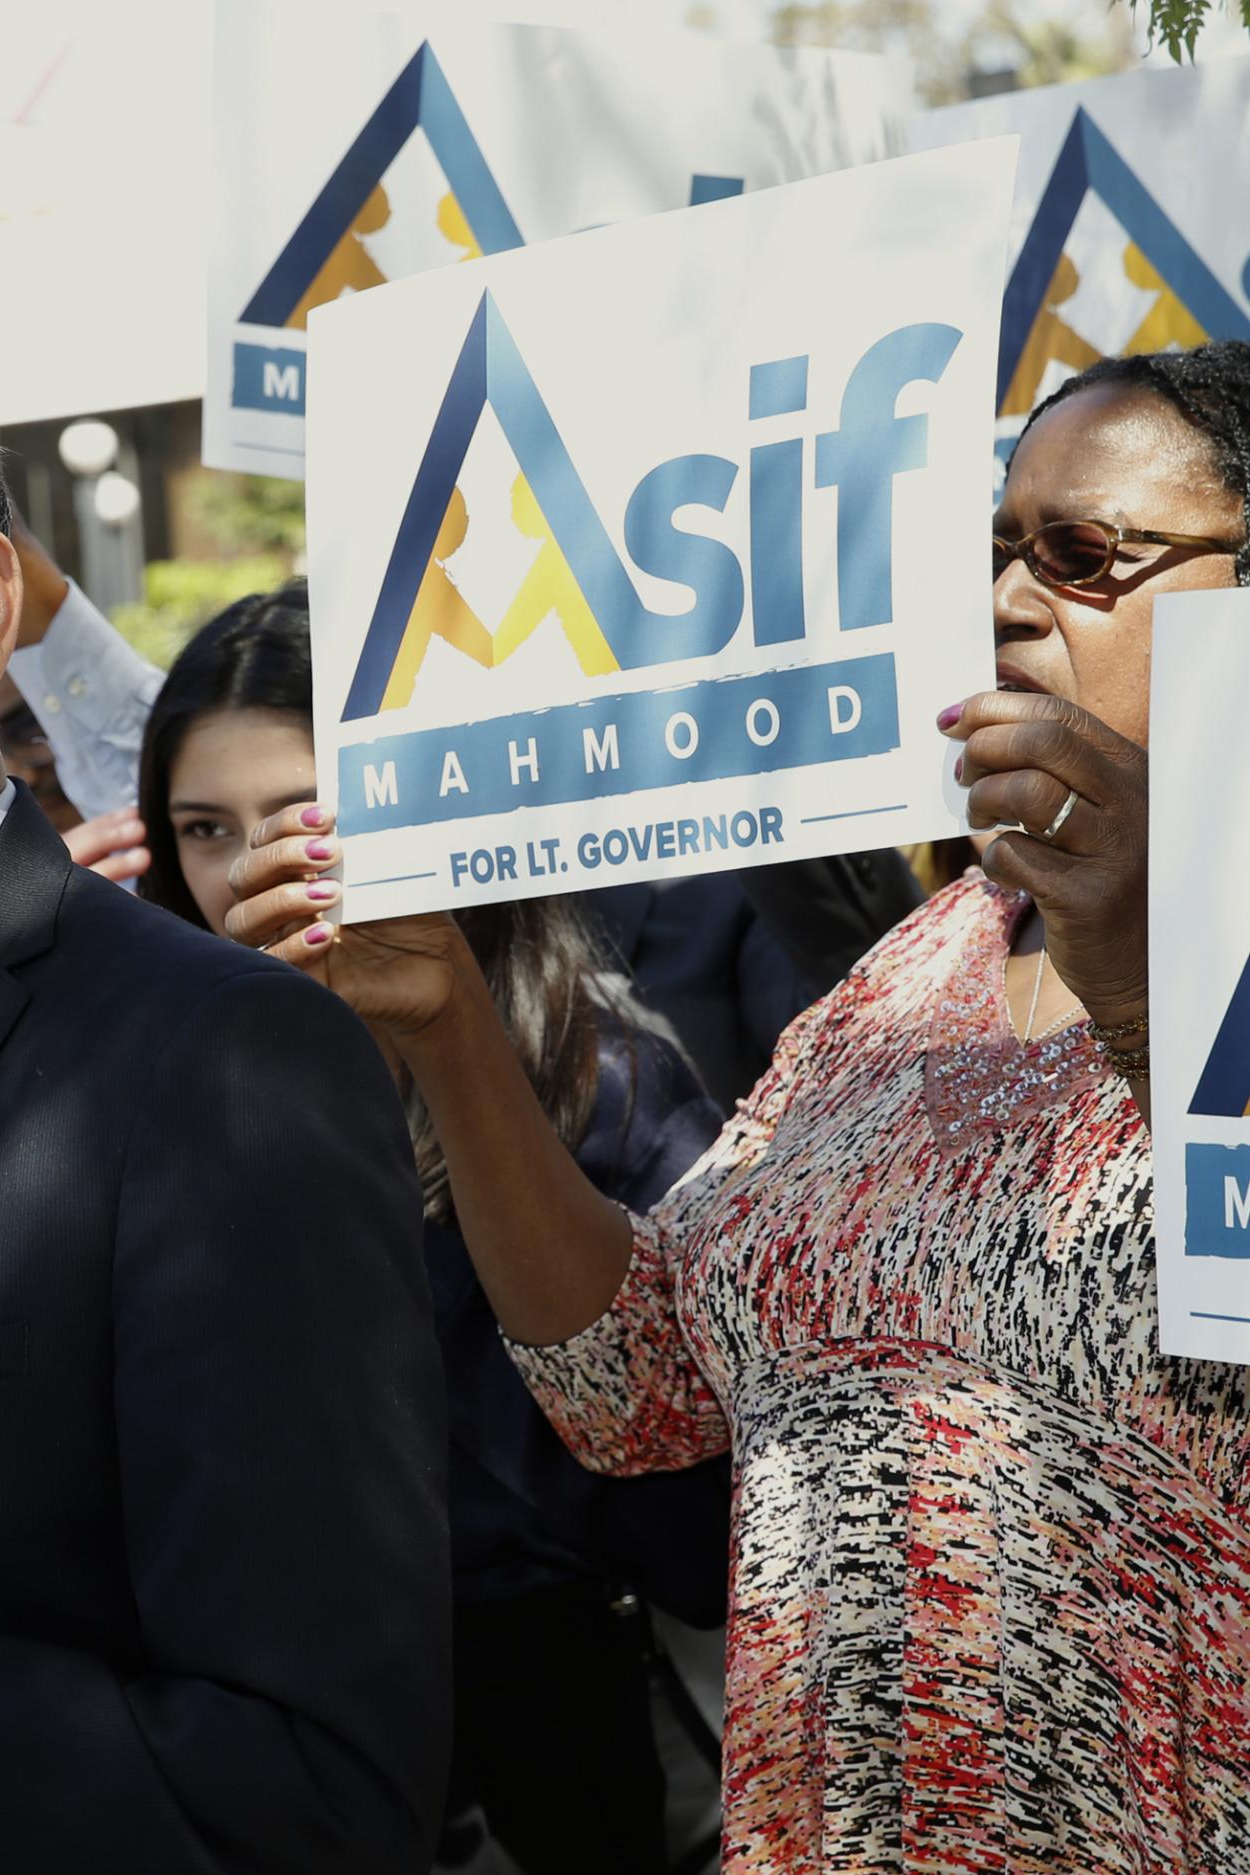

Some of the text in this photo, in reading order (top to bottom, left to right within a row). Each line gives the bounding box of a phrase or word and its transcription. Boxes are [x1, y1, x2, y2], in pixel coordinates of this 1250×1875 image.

[340, 286, 964, 723] Asif
[362, 684, 863, 809] MAHMOOD
[448, 805, 786, 888] FOR LT. GOVERNOR
